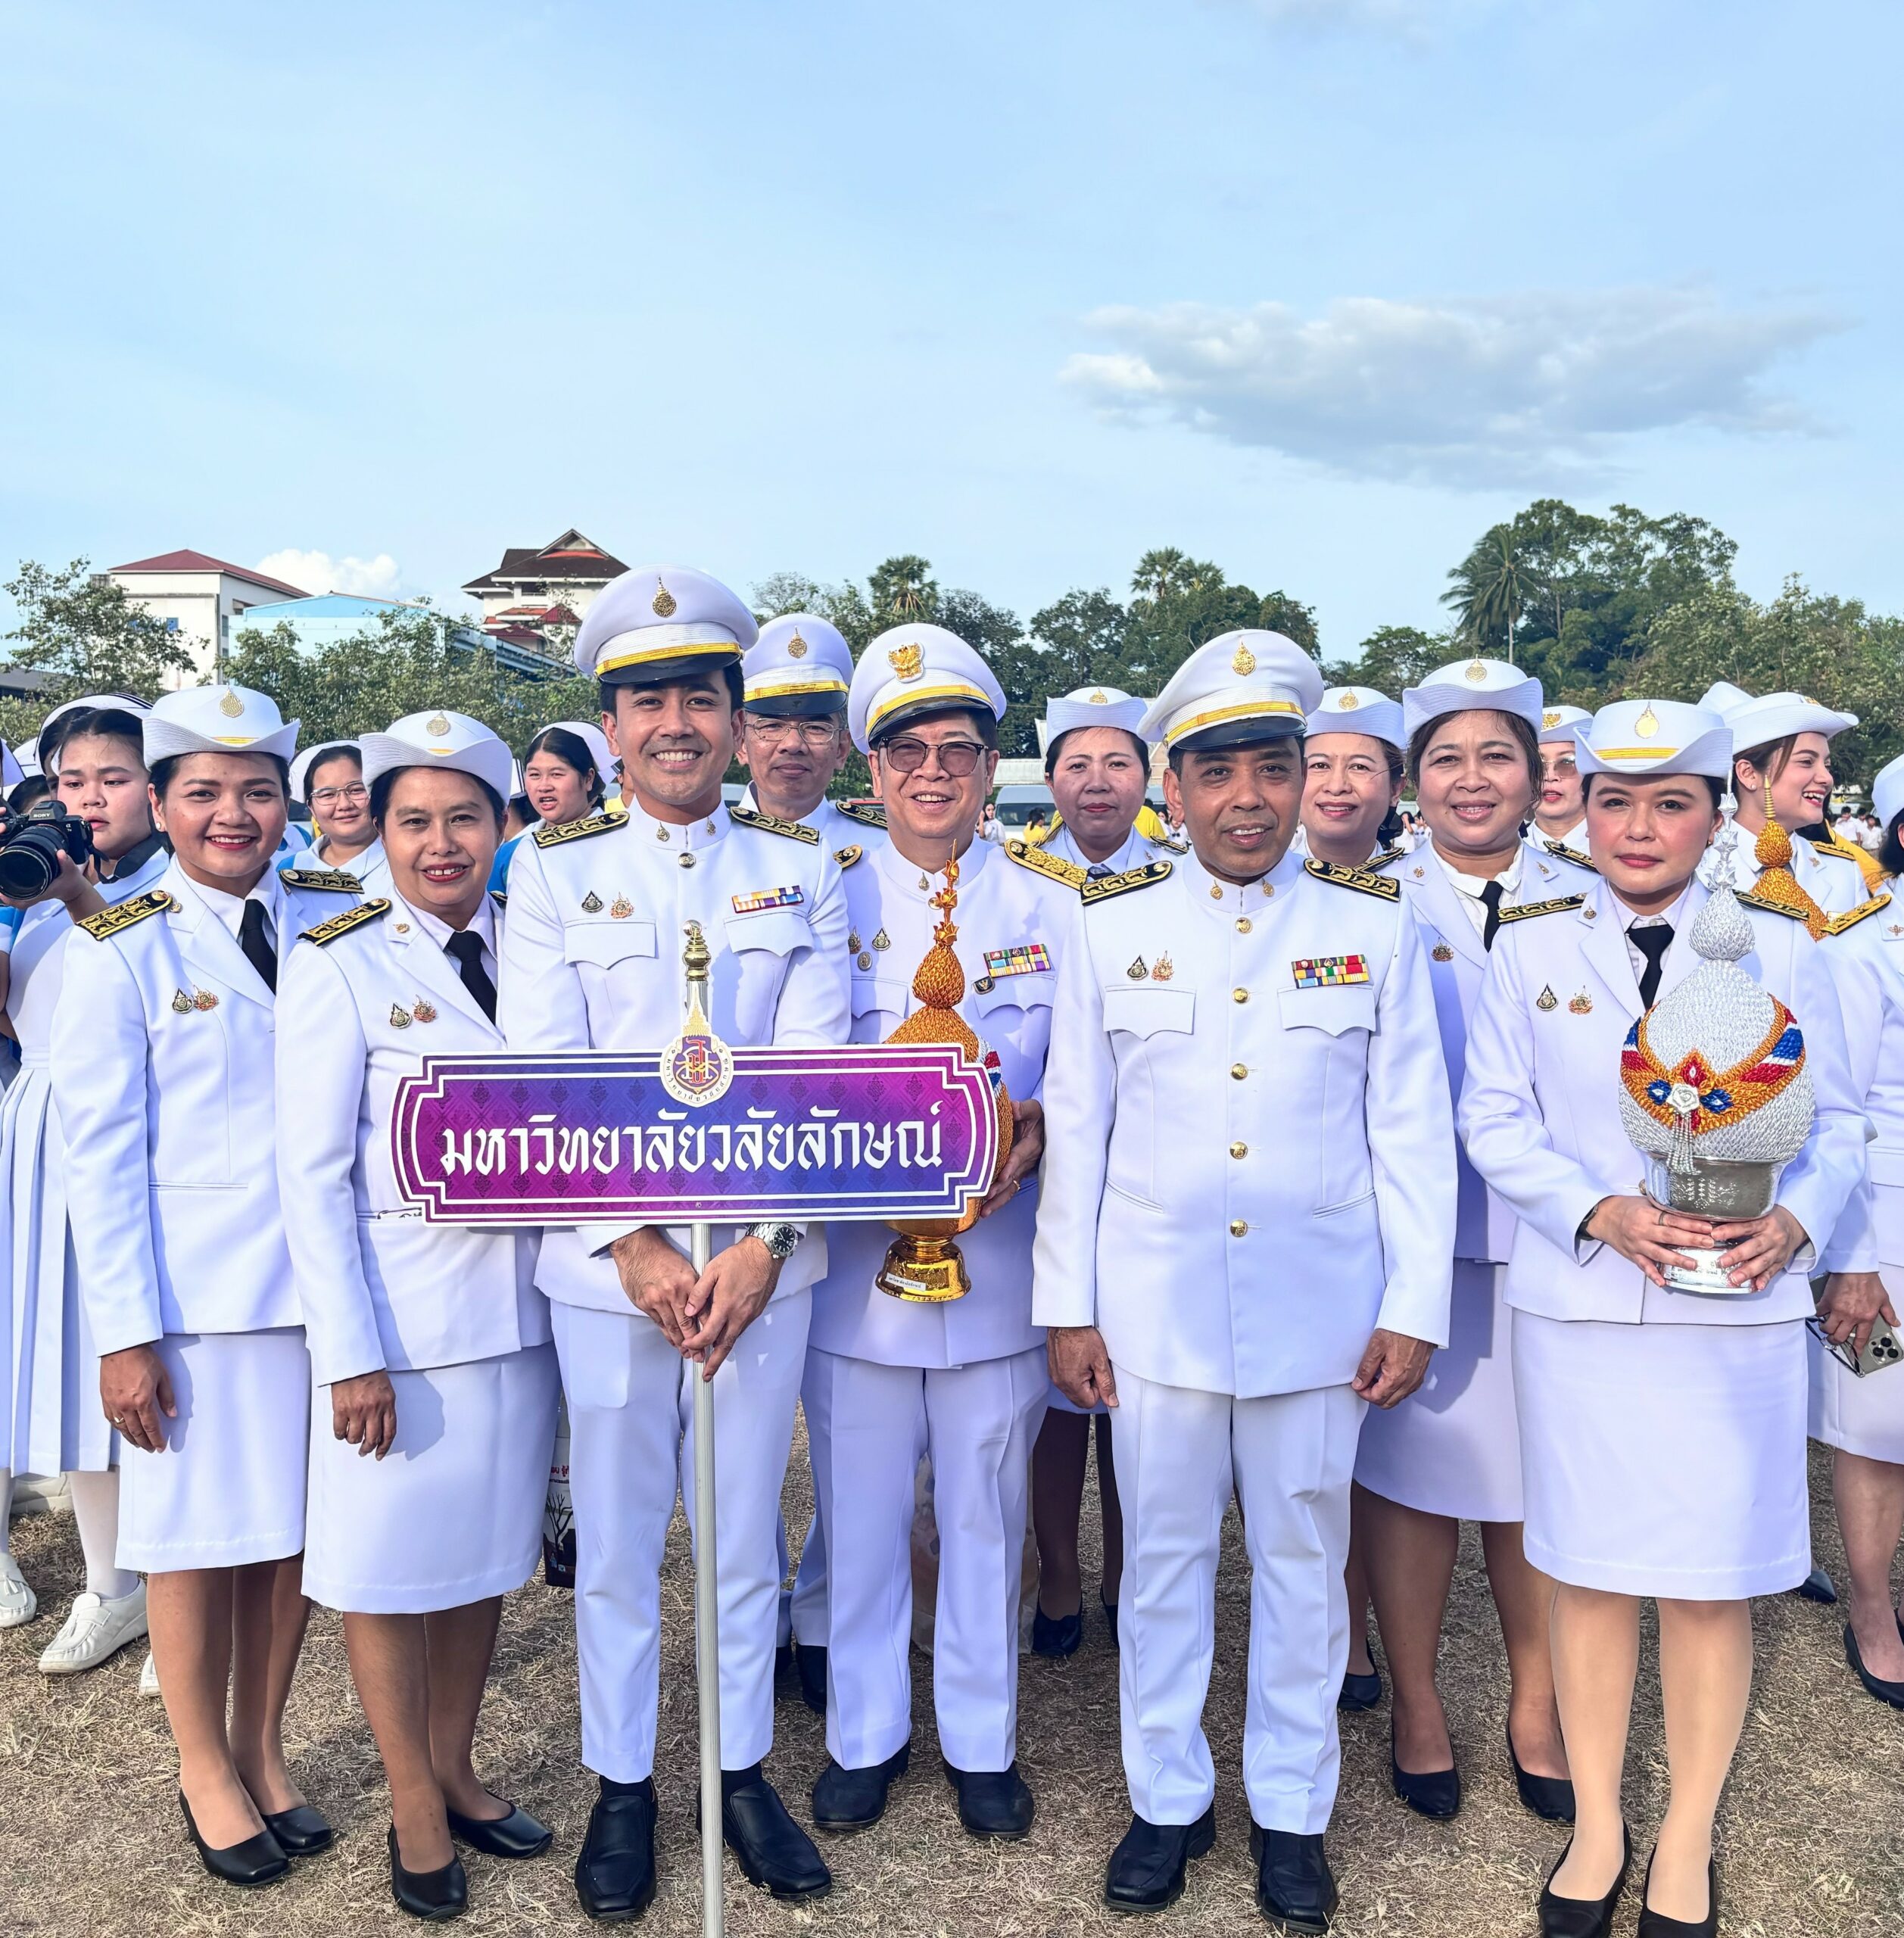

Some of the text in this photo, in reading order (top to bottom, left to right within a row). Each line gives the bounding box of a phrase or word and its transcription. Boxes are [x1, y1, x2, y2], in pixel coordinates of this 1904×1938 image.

[439, 1100, 943, 1176] มหาวิทยาลัยวลัยลักษณ์
